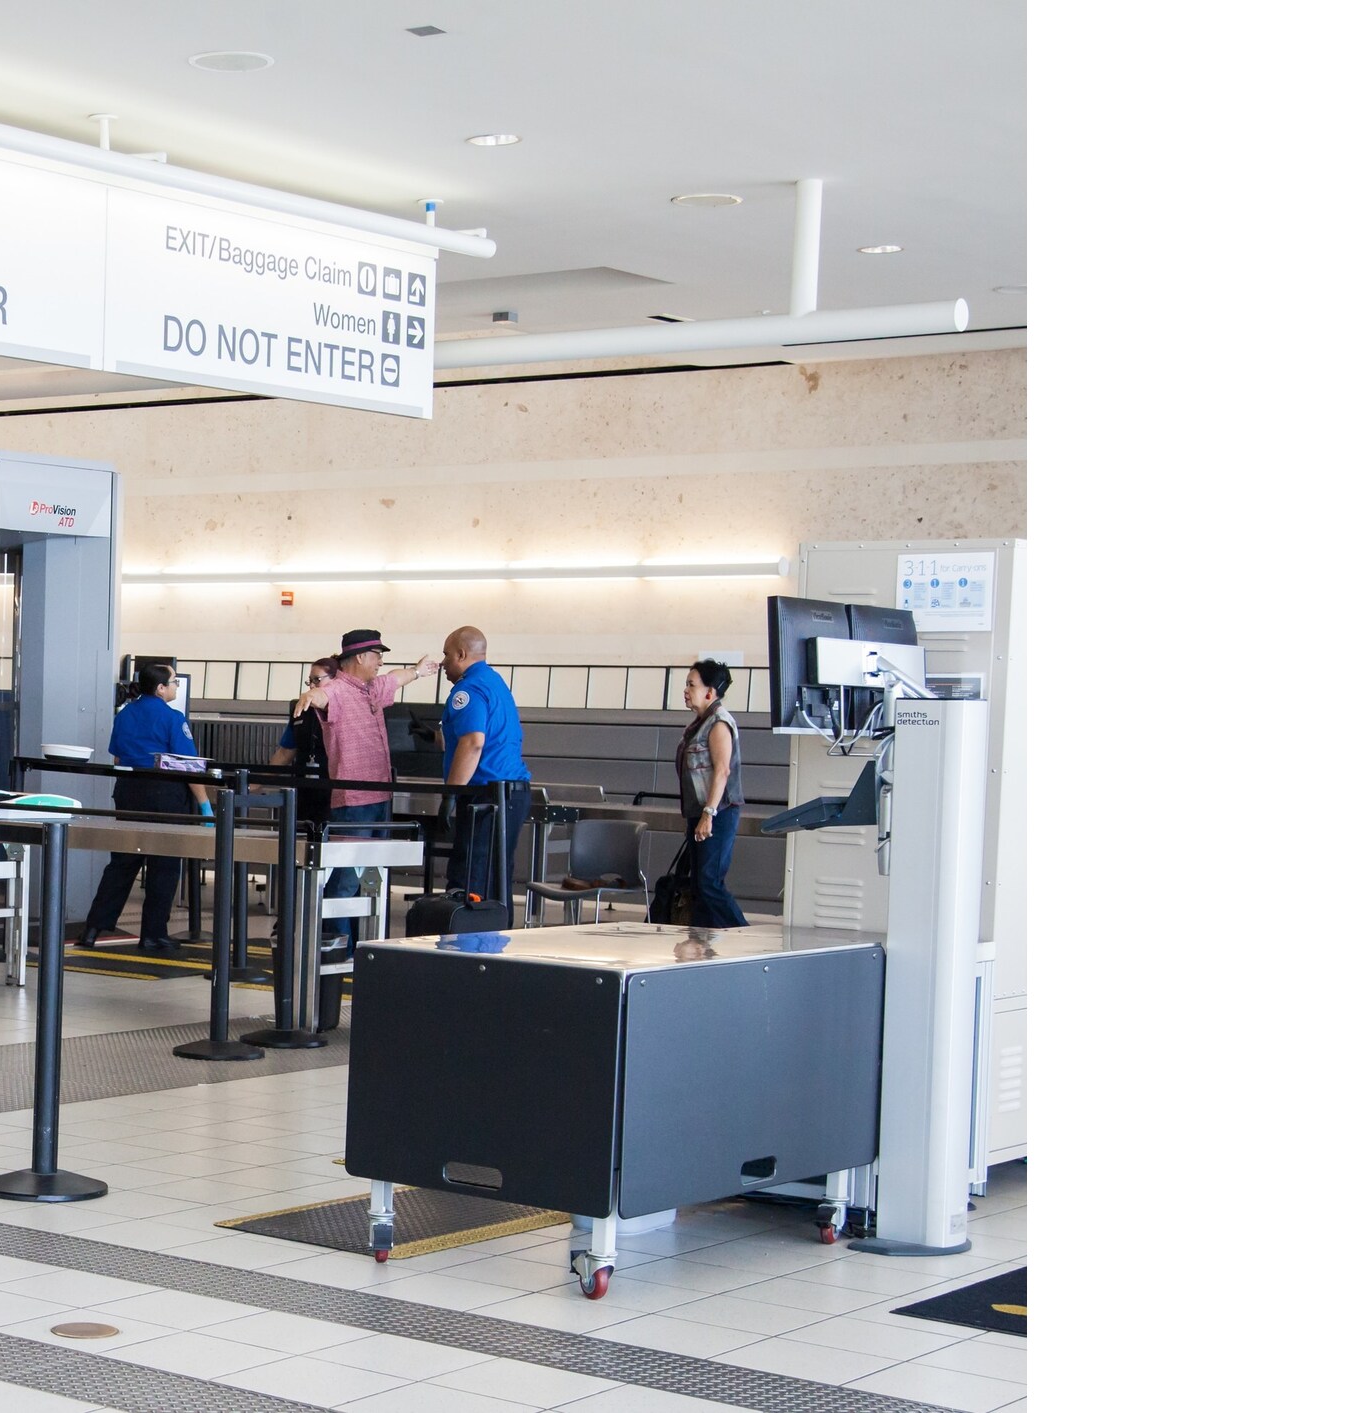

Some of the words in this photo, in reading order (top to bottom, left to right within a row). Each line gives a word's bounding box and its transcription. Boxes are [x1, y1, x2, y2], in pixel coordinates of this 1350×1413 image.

[165, 225, 299, 280] EXIT/Baggage
[304, 256, 352, 288] Claim
[313, 302, 376, 336] Women
[163, 314, 207, 357] DO
[217, 324, 278, 368] NOT
[286, 336, 375, 384] ENTER
[40, 504, 76, 516] ProVision
[58, 517, 74, 527] ATD
[897, 718, 940, 726] detection
